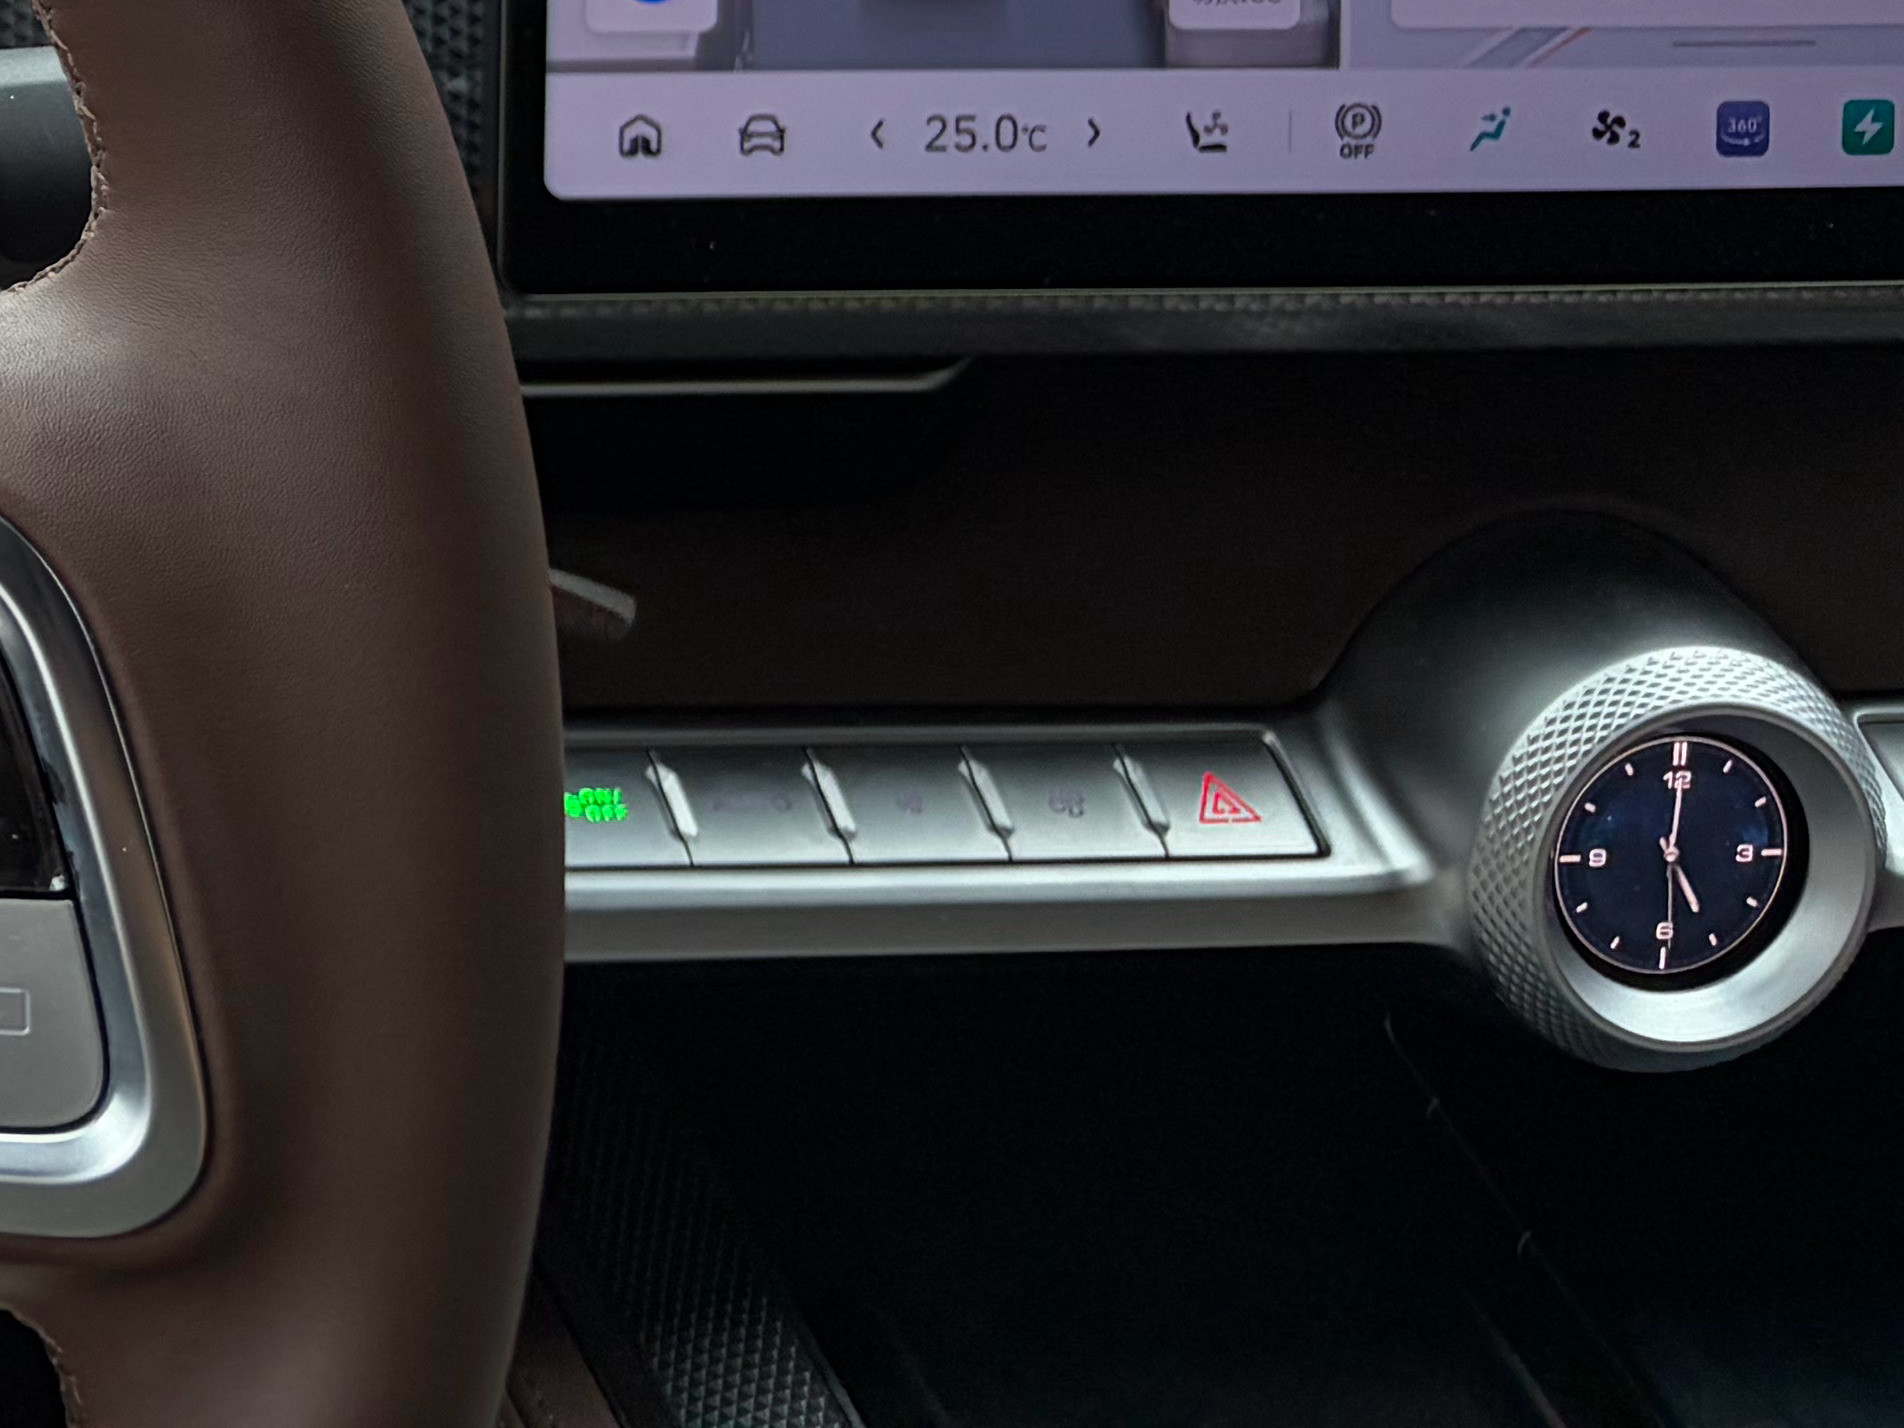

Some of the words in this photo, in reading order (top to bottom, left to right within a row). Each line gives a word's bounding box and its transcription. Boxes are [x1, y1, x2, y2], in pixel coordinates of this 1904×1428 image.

[1338, 143, 1375, 160] OFF
[1663, 771, 1691, 789] 12
[1589, 849, 1606, 866] 9
[1736, 844, 1753, 862] 3
[1656, 922, 1674, 939] 6
